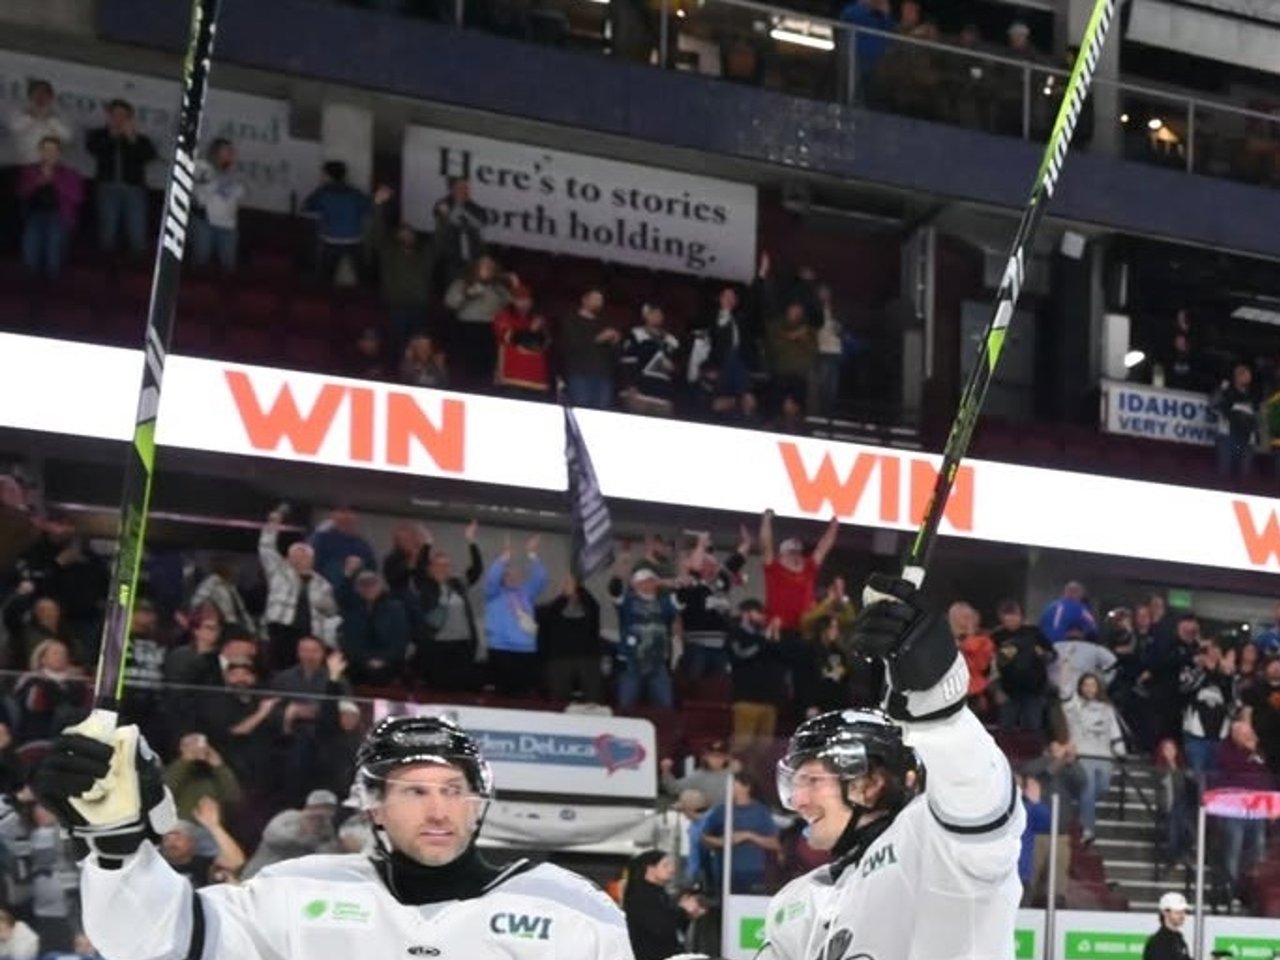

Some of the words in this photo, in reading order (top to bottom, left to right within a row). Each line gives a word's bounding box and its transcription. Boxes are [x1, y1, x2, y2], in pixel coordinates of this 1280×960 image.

[438, 146, 556, 196] Here's
[566, 176, 601, 203] to
[612, 185, 728, 225] stories
[480, 202, 557, 237] orth
[569, 209, 718, 270] holding.
[225, 370, 466, 473] WIN
[1117, 415, 1169, 436] VERY
[779, 441, 975, 532] WIN
[519, 735, 597, 758] DeLuca
[489, 911, 553, 941] CWI
